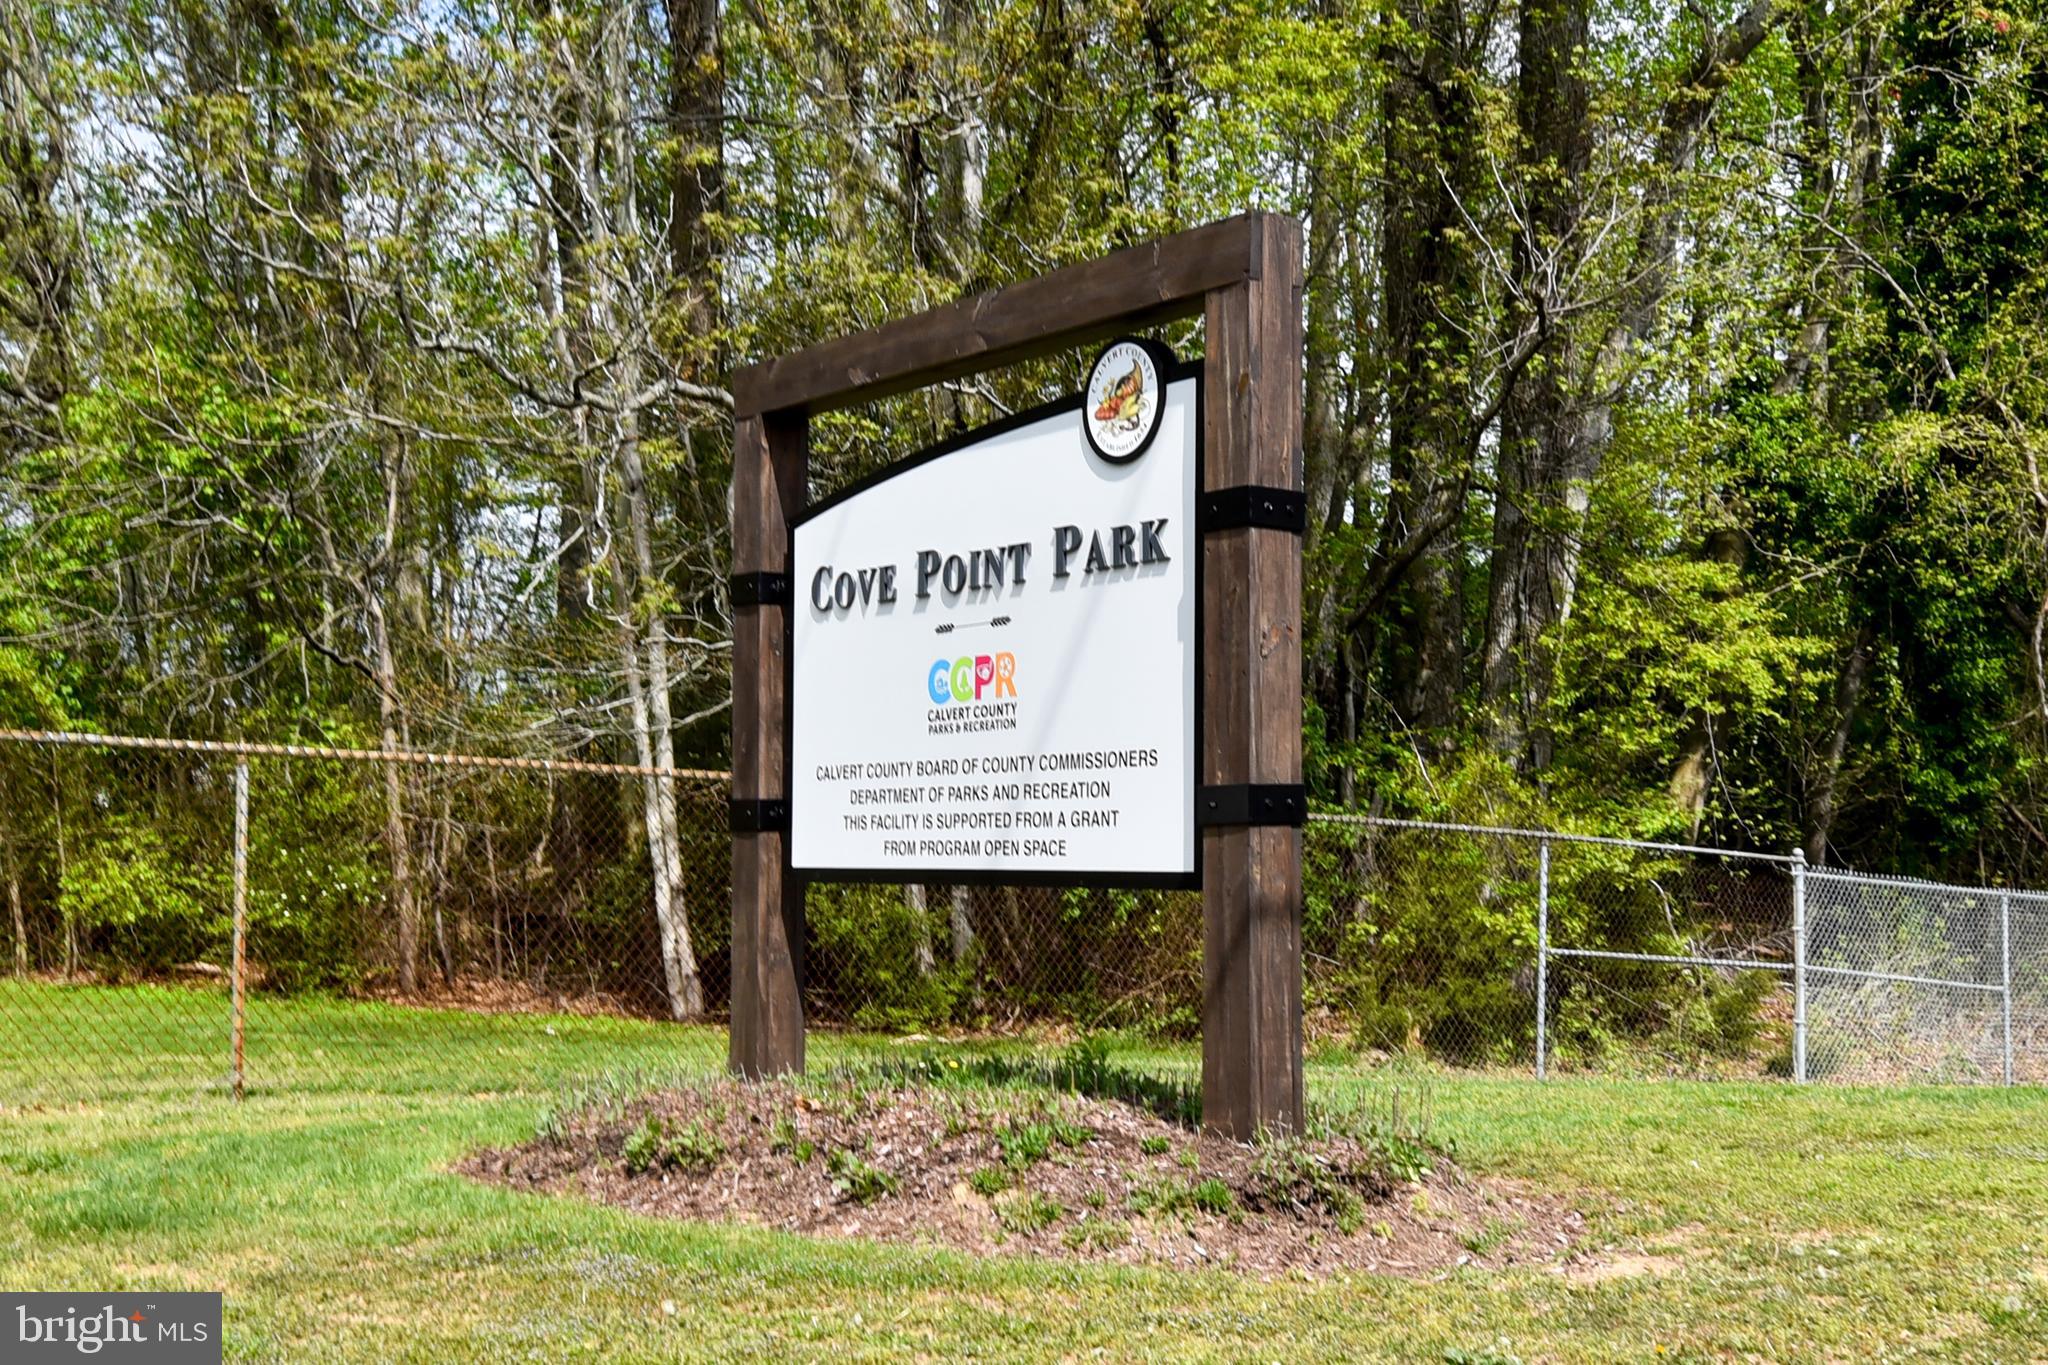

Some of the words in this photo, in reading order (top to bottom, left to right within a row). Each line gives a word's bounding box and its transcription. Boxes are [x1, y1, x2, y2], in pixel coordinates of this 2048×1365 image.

[811, 565, 897, 612] COVE
[915, 542, 1031, 599] POINT
[1053, 518, 1171, 578] PARK
[928, 652, 1018, 704] CCPR
[928, 706, 971, 722] CALVERT
[973, 702, 1017, 718] COUNTY
[928, 723, 954, 735] PARKS
[963, 718, 1017, 733] RECREATION
[816, 764, 864, 782] CALVERT
[866, 761, 913, 779] COUNTY
[916, 759, 958, 777] BOARD
[961, 758, 979, 775] OF
[982, 755, 1035, 774] COUNTY
[1039, 749, 1158, 771] COMMISSIONERS
[850, 787, 926, 805] DEPARTMENT
[928, 786, 944, 803] OF
[948, 785, 988, 802] PARKS
[992, 784, 1020, 801] AND
[1023, 781, 1111, 800] RECREATION
[843, 815, 868, 831] THIS
[870, 814, 919, 831] FACILITY
[922, 813, 933, 830] IS
[936, 811, 1012, 830] SUPPORTED
[1015, 811, 1053, 828] FROM
[1057, 811, 1067, 828] A
[1070, 810, 1120, 828] GRANT
[884, 840, 916, 856] FROM
[919, 840, 981, 856] PROGRAM
[984, 839, 1020, 856] OPEN
[1023, 839, 1067, 856] SPACE
